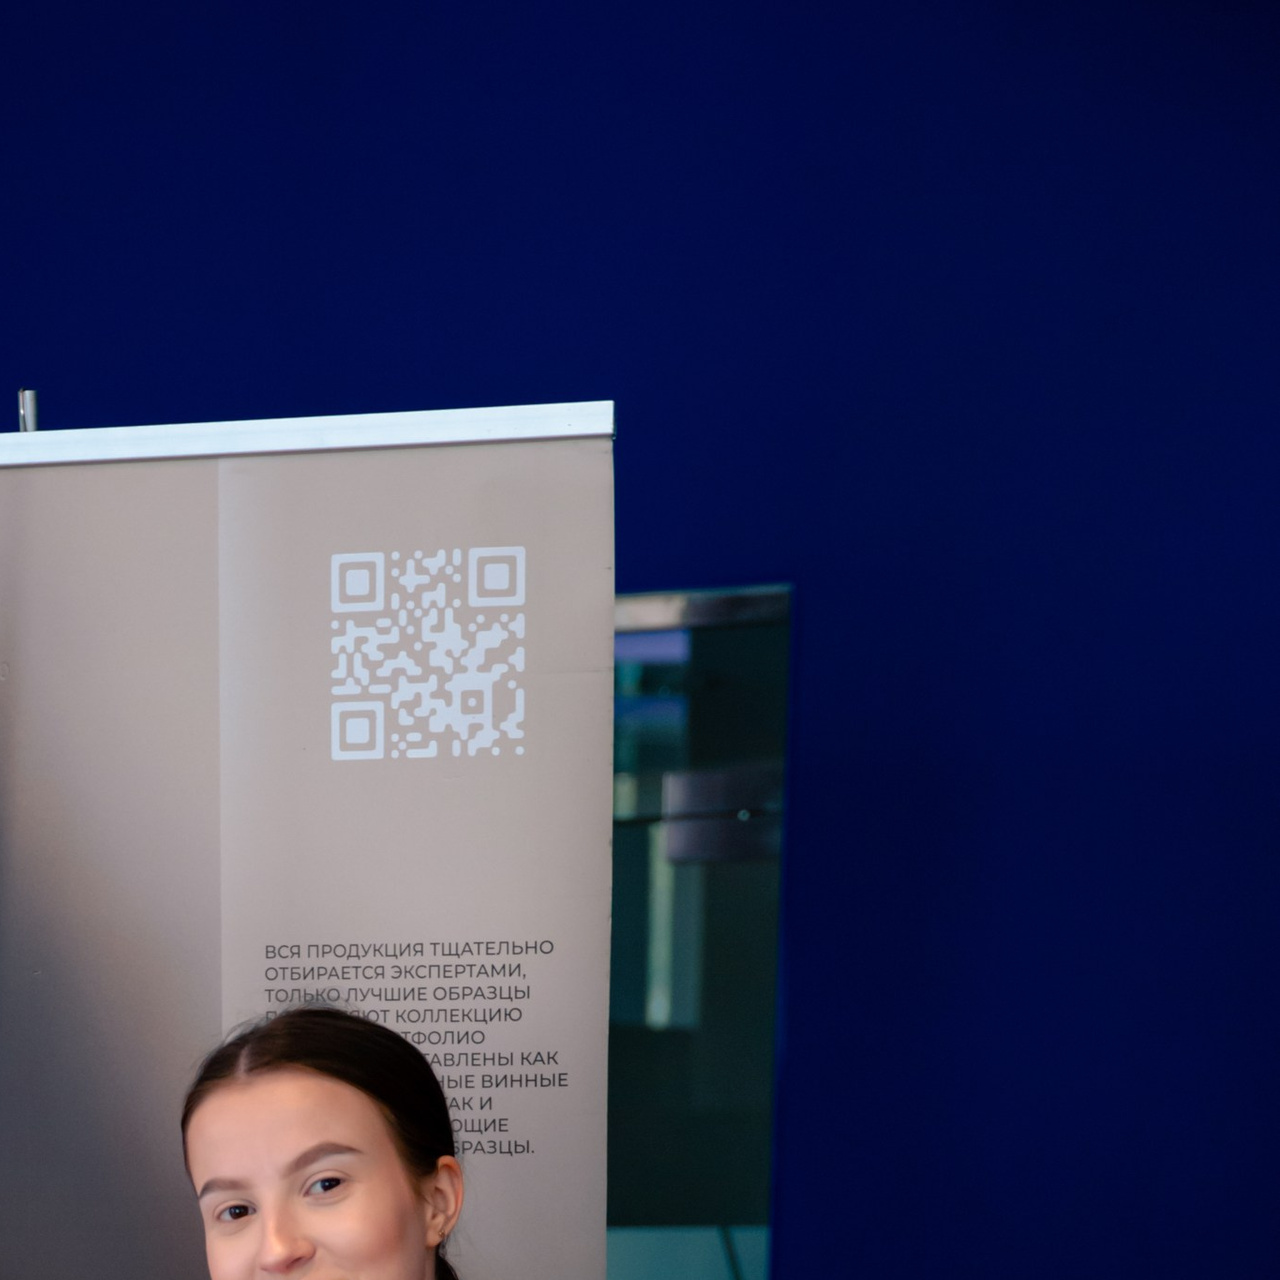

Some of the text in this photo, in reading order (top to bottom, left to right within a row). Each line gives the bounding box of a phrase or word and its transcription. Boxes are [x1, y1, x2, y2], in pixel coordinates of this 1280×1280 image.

[265, 940, 554, 961] ВСЯ ПРОДУКЦИЯ ТЩАТЕЛЬНО
[264, 963, 527, 981] ОТБИРАЕТСЯ ЭКСПЕРТАМИ,
[264, 985, 531, 1003] ТОЛЬКО ЛУЧШИЕ ОБРАЗЦЫ
[395, 1007, 523, 1025] КОЛЛЕКЦИЮ
[521, 1051, 559, 1066] КАК
[481, 1072, 569, 1089] ВИННЫЕ
[480, 1096, 492, 1111] И
